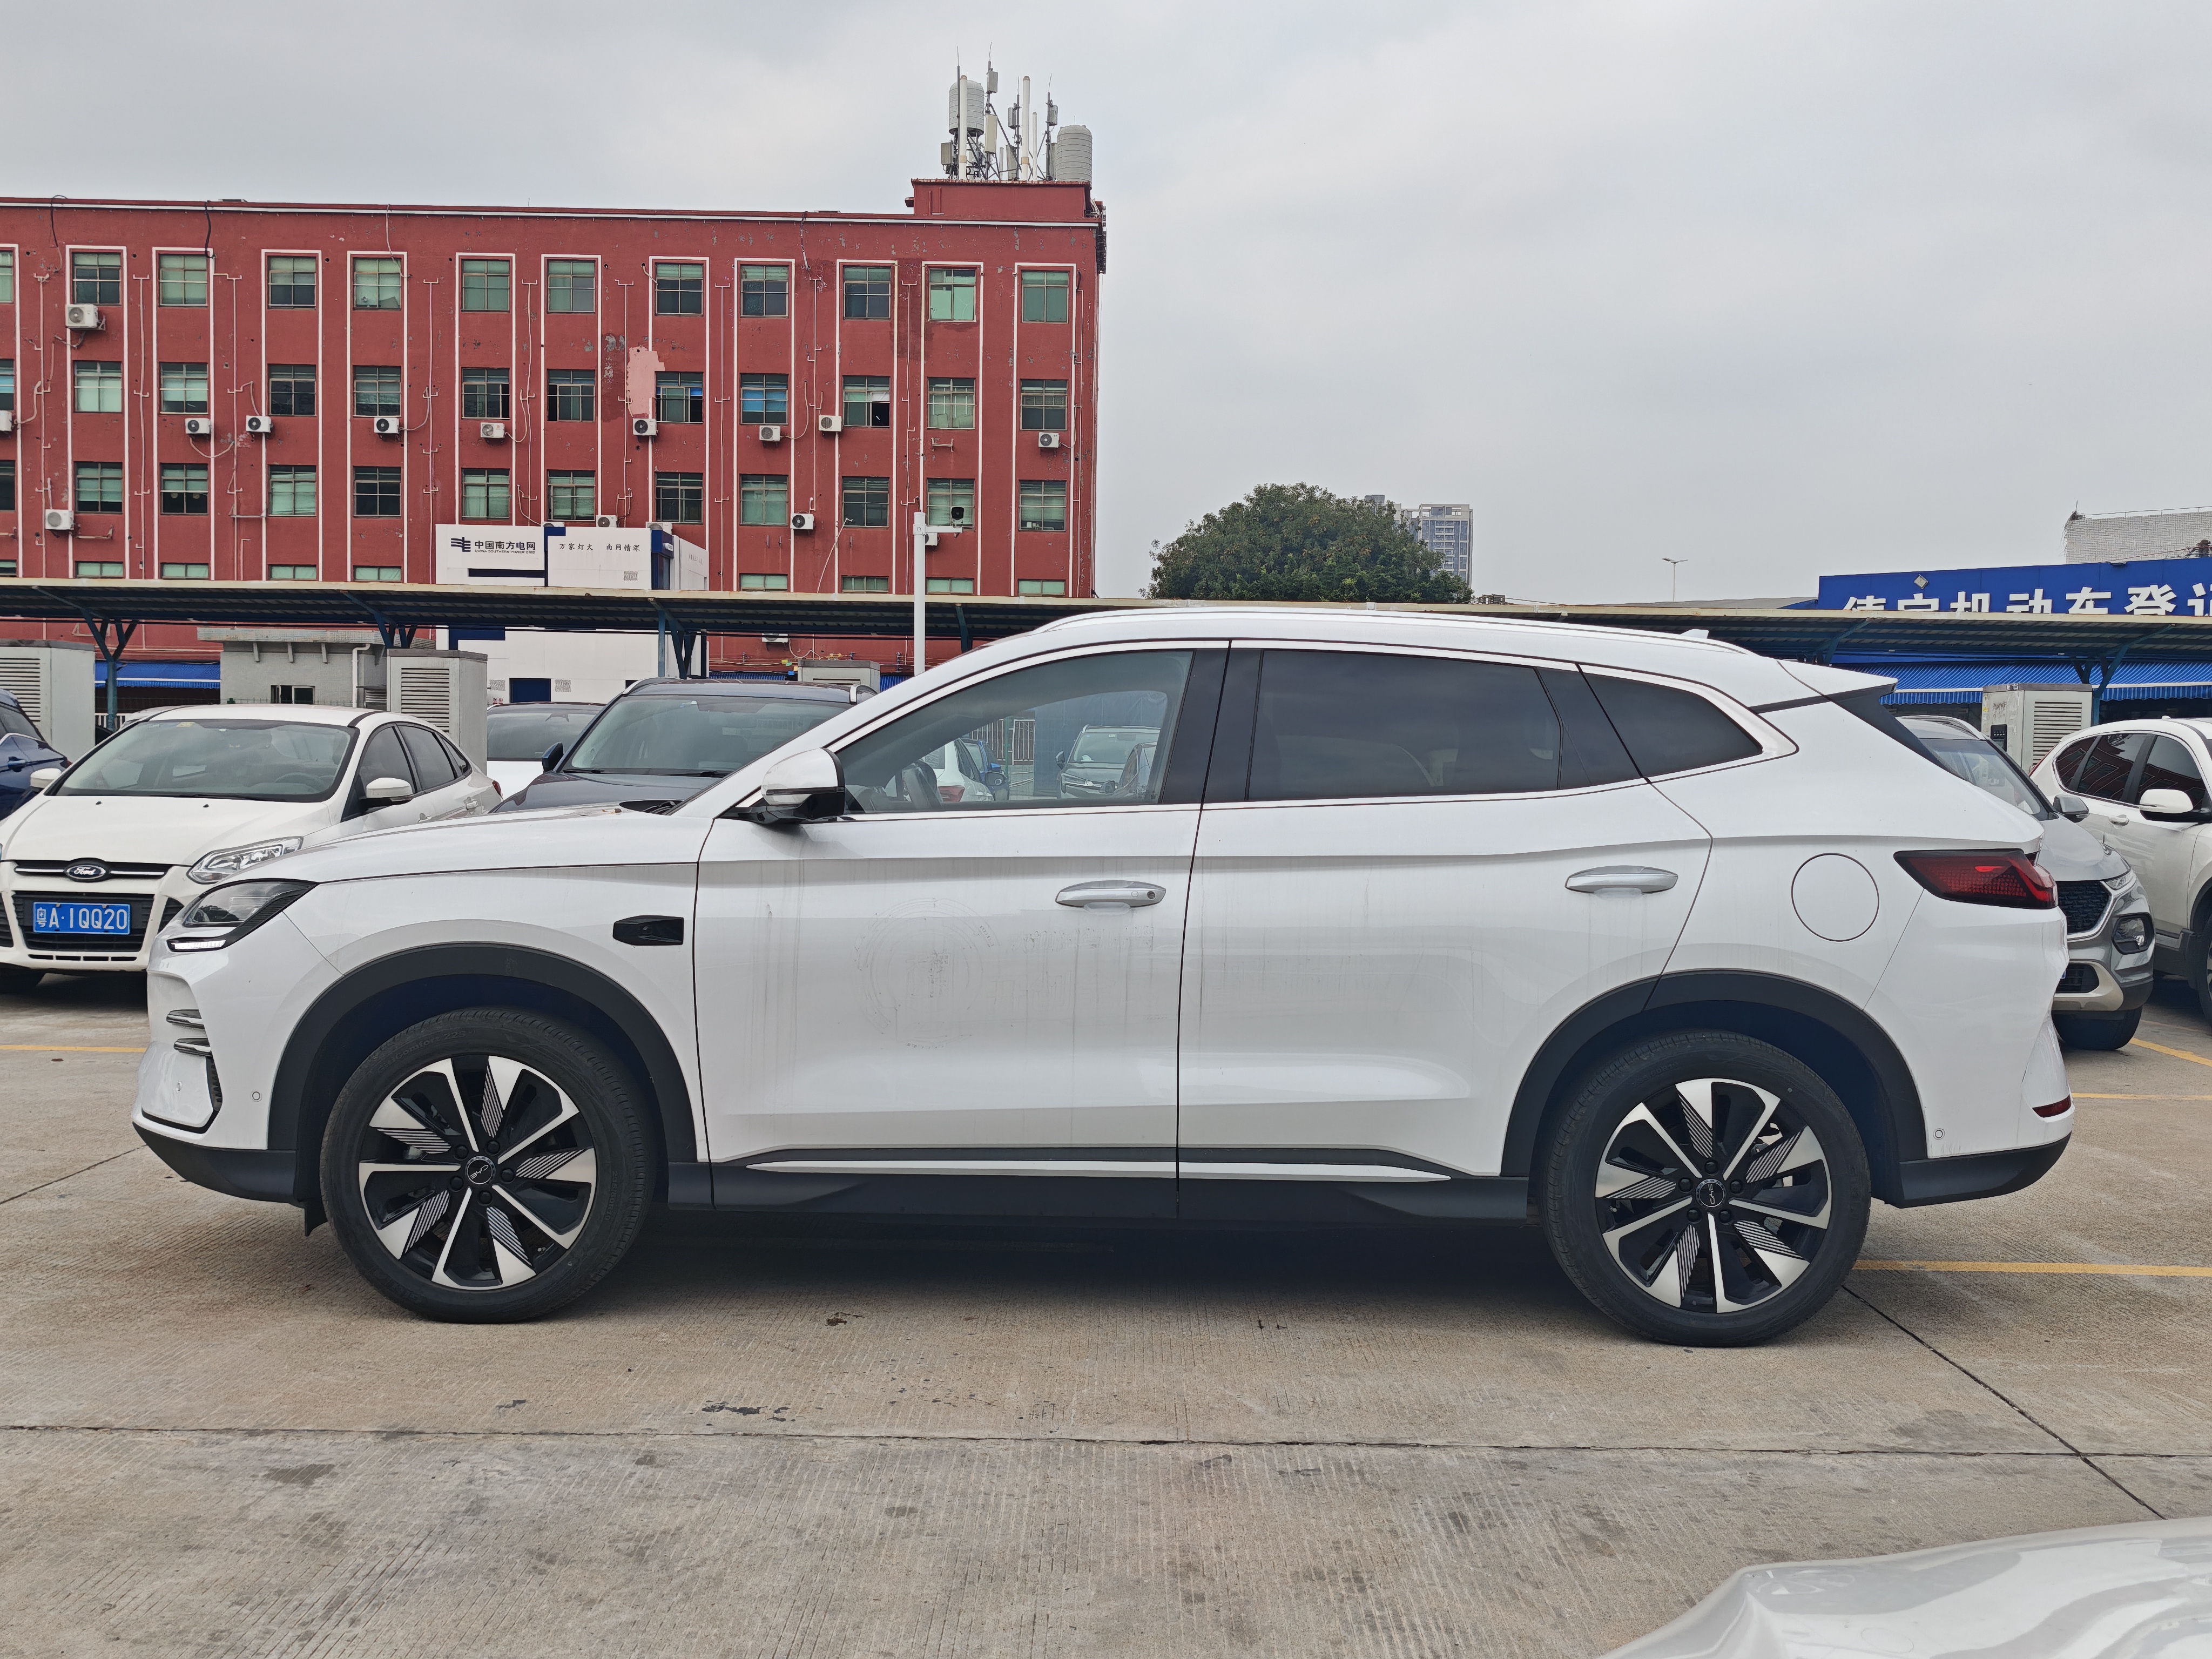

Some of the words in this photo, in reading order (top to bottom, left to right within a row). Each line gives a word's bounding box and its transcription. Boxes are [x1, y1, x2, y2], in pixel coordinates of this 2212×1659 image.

[475, 541, 536, 550] 中国南方电网
[606, 543, 640, 552] 南网情深
[74, 866, 97, 875] Ford
[470, 1164, 489, 1179] BYD
[1707, 1183, 1715, 1205] BYD
